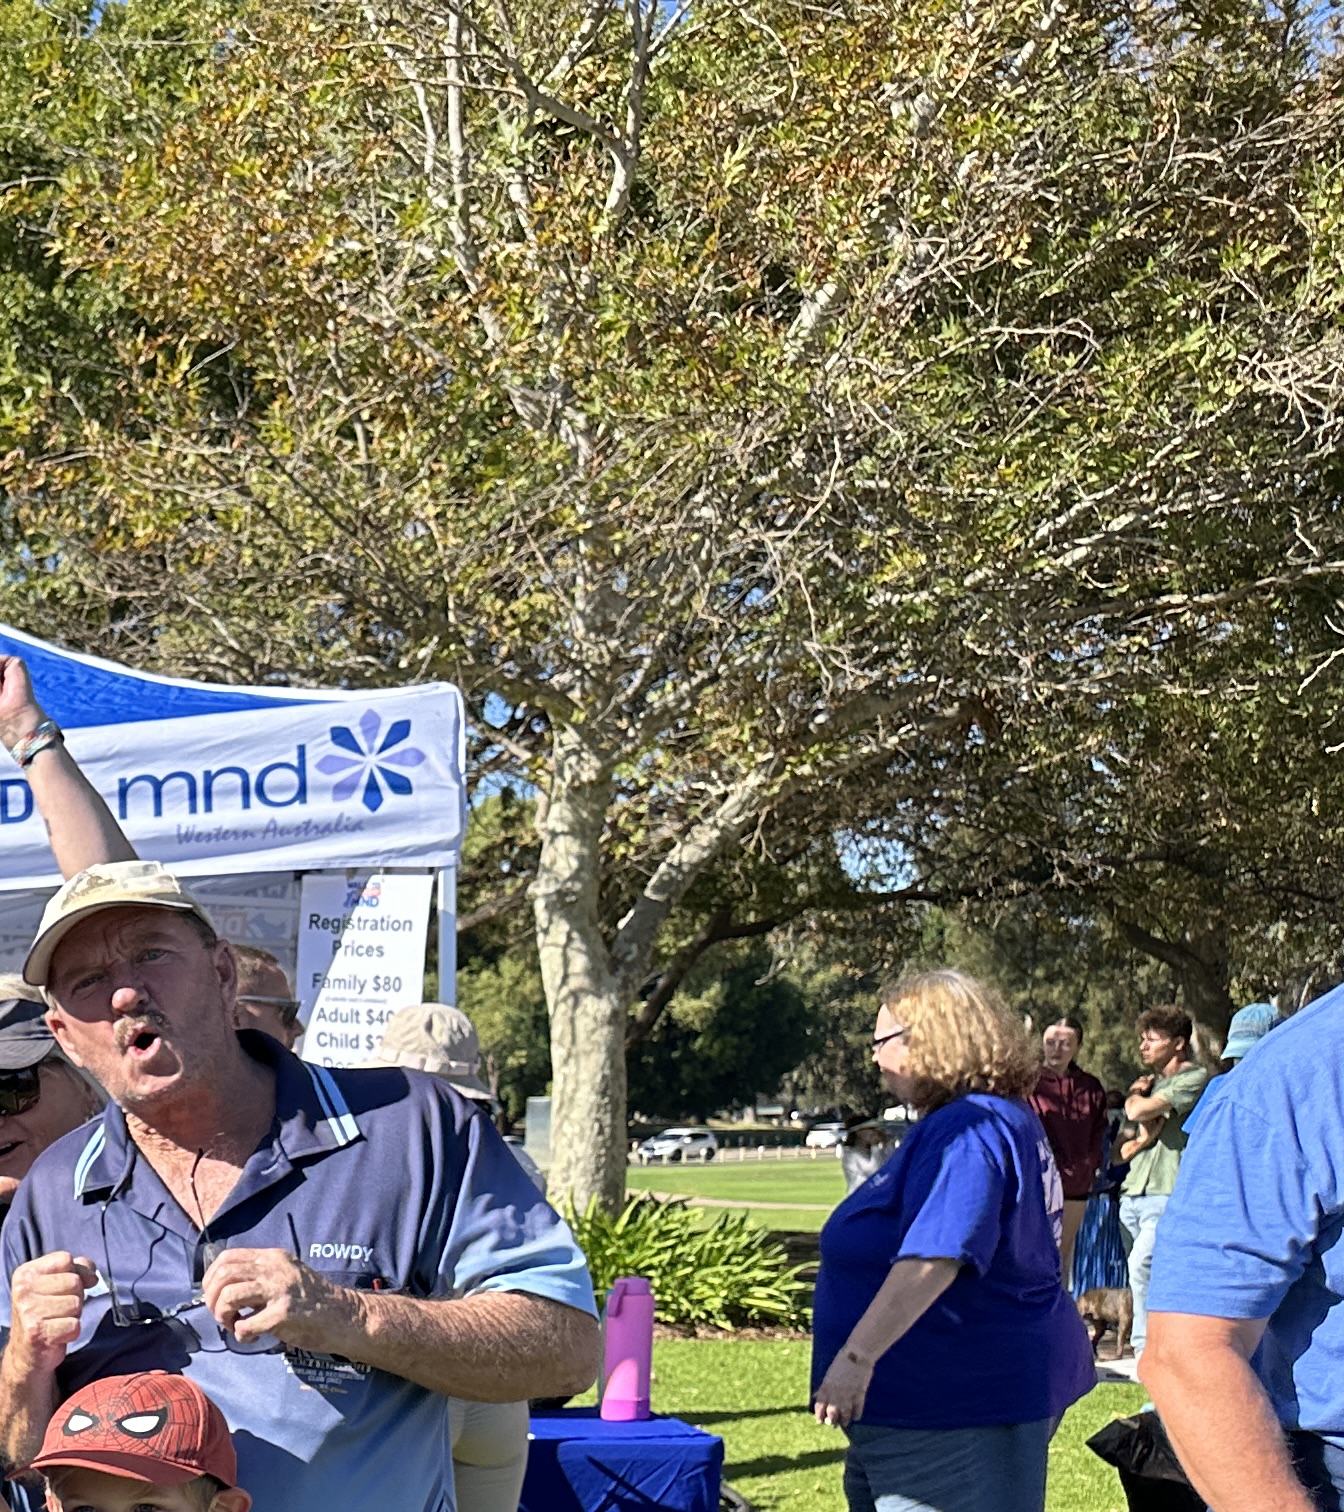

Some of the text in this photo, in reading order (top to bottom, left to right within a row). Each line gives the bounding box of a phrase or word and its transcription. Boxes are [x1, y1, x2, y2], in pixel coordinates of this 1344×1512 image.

[118, 744, 309, 820] mnd
[176, 812, 365, 845] Western Australia
[308, 913, 413, 934] Registration
[332, 940, 385, 958] Prices
[311, 973, 402, 995] Family $80
[316, 1008, 361, 1024] Adult
[316, 1032, 360, 1050] Child
[309, 1243, 374, 1262] ROWDY
